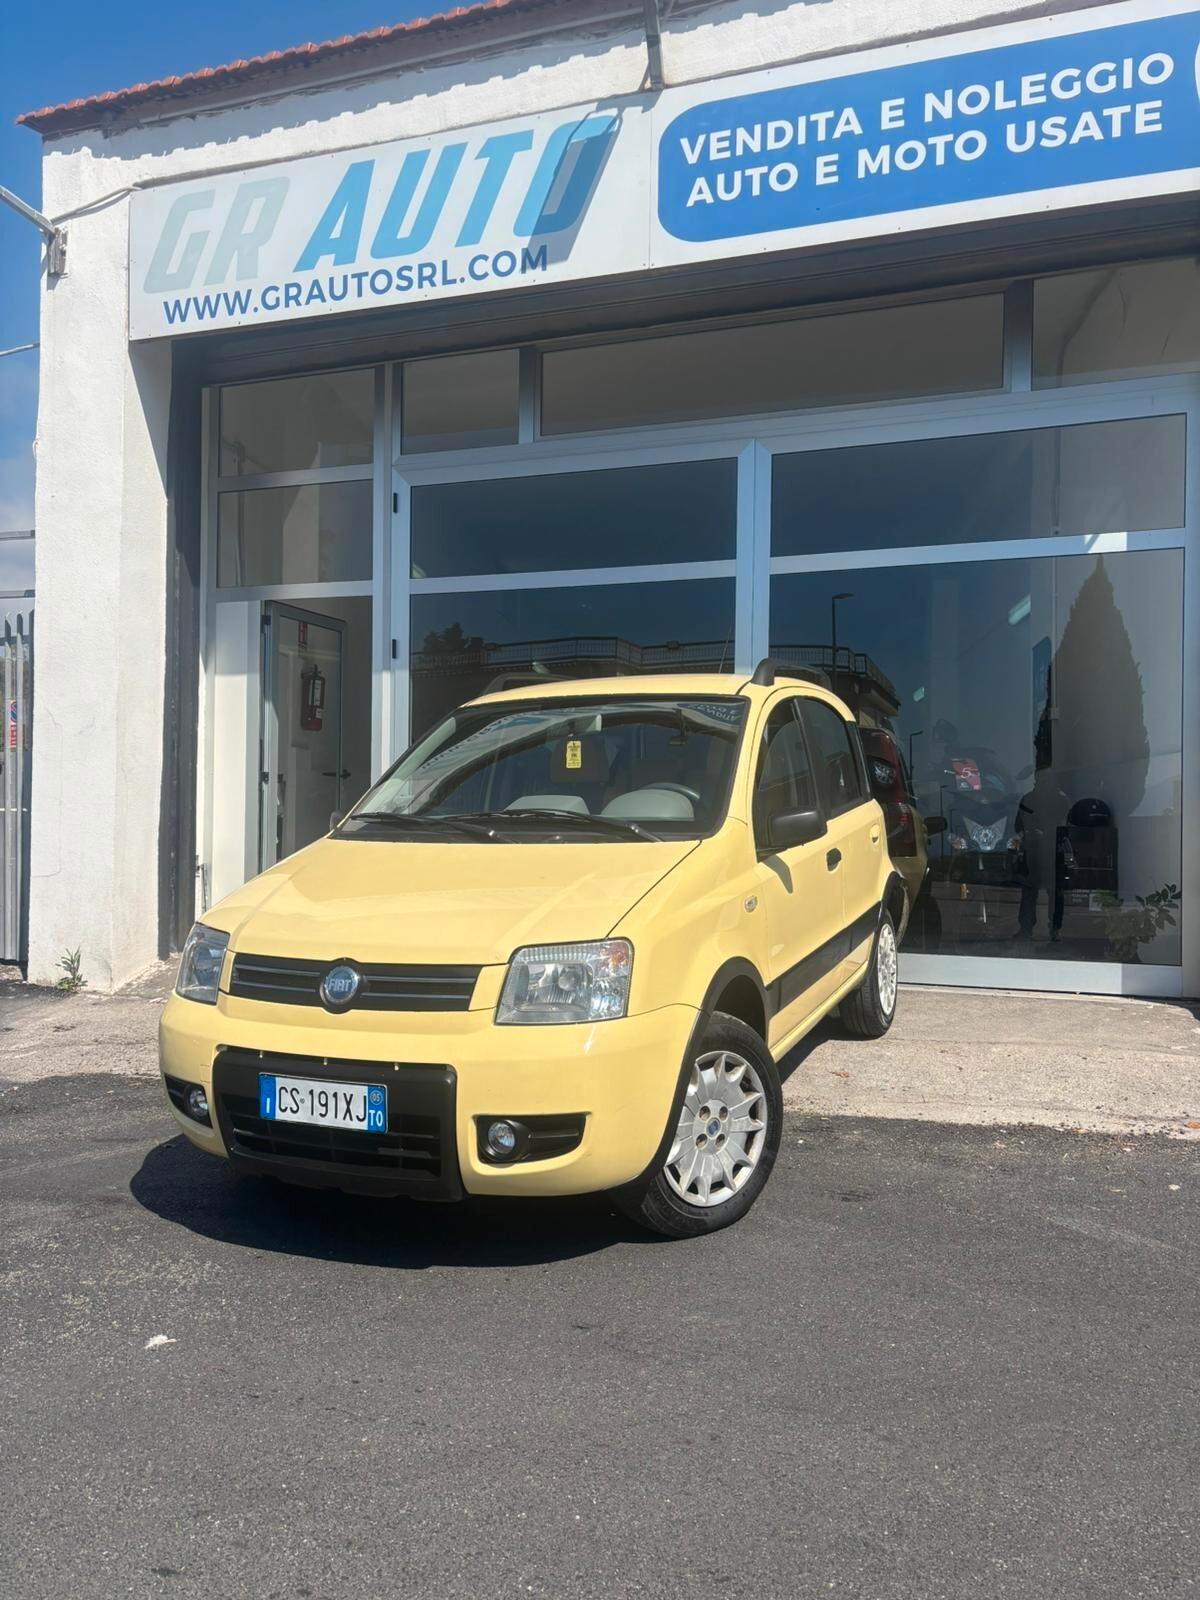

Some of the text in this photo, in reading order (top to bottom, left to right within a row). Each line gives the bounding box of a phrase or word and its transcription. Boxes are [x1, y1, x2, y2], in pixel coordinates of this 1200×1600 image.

[680, 52, 1175, 165] VENDITA E NOLEGGIO
[686, 99, 1164, 207] AUTO E MOTO USATE
[143, 115, 620, 294] GR AUTO
[163, 244, 548, 325] WWW.GRAUTOSRL.COM
[327, 979, 353, 993] FIAT
[368, 1109, 383, 1127] TO
